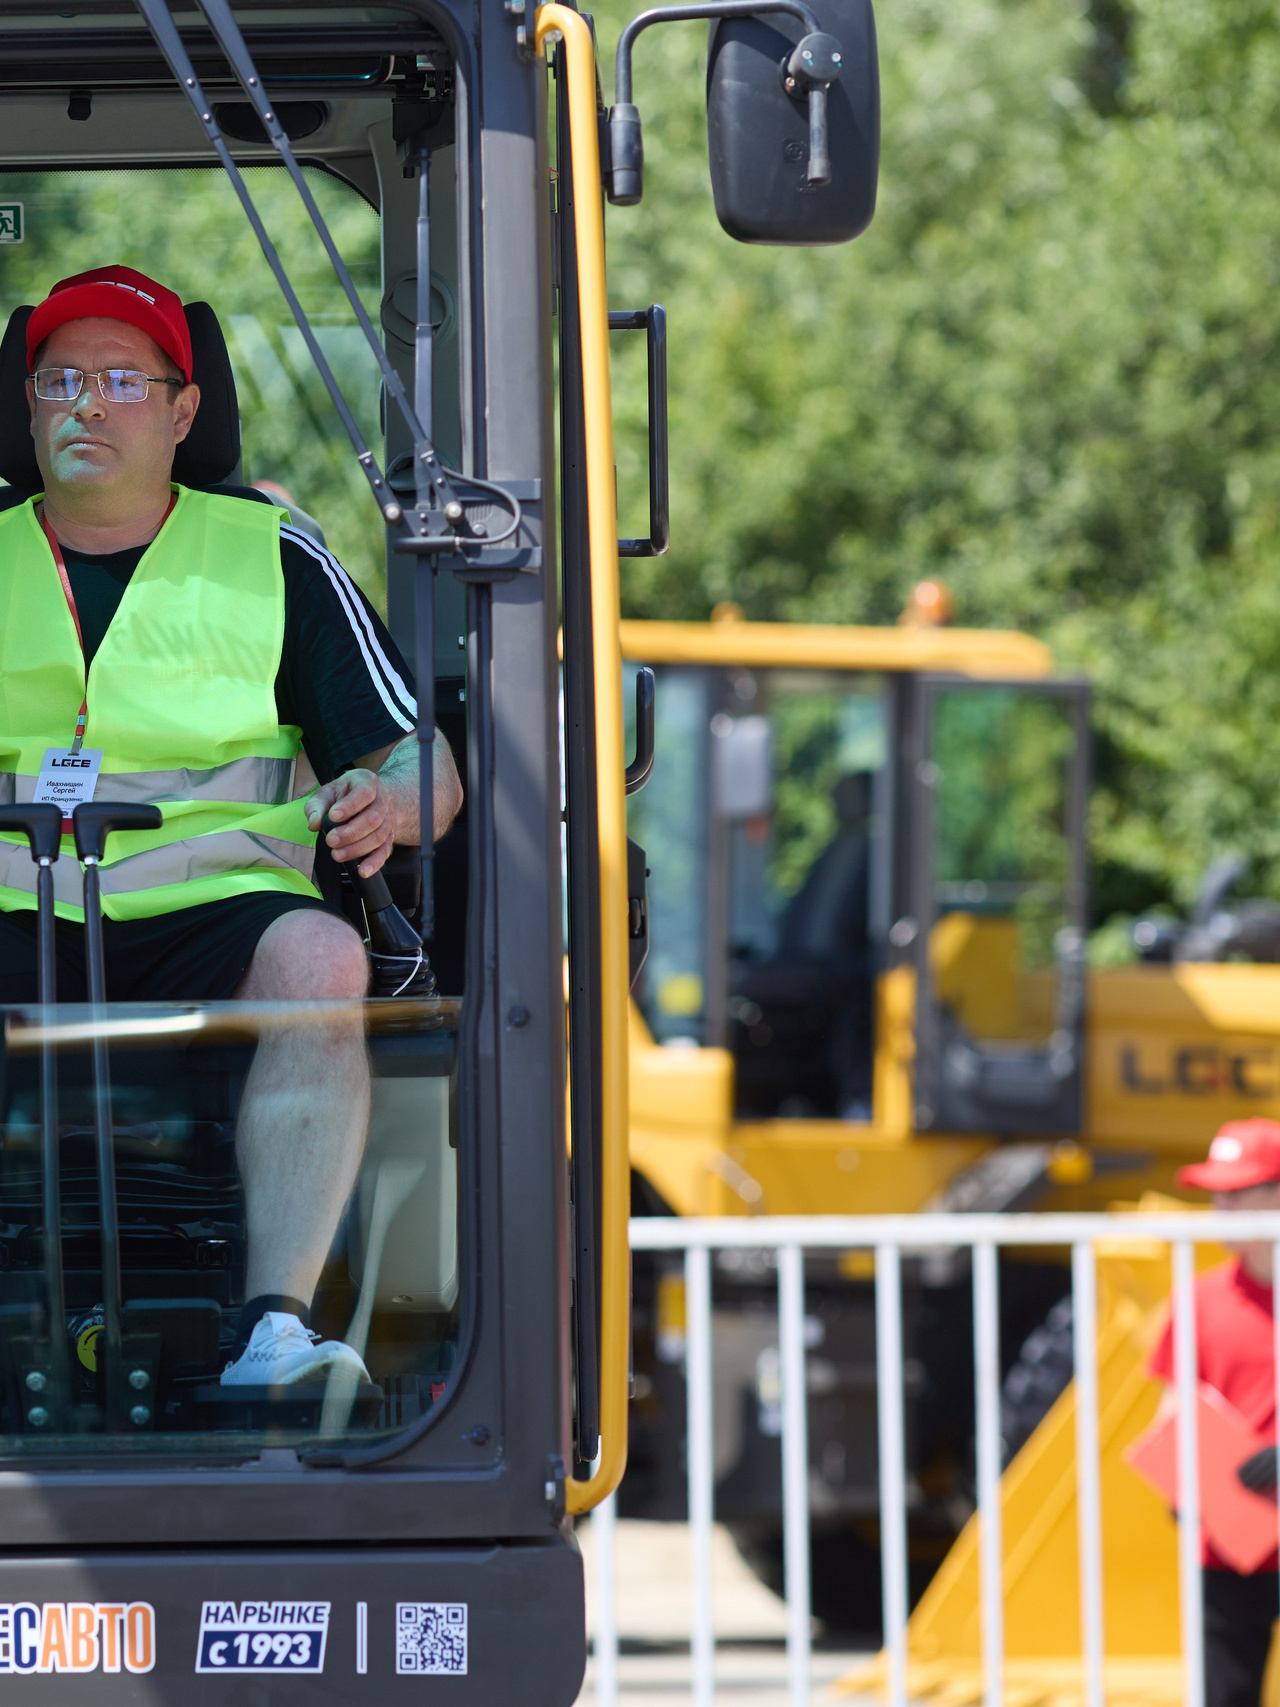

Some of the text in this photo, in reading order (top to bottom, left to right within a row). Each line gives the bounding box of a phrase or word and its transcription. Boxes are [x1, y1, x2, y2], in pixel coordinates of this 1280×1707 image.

[51, 758, 91, 768] LGCE
[204, 1604, 327, 1624] НА РЫНКЕ
[233, 1632, 312, 1665] 1993
